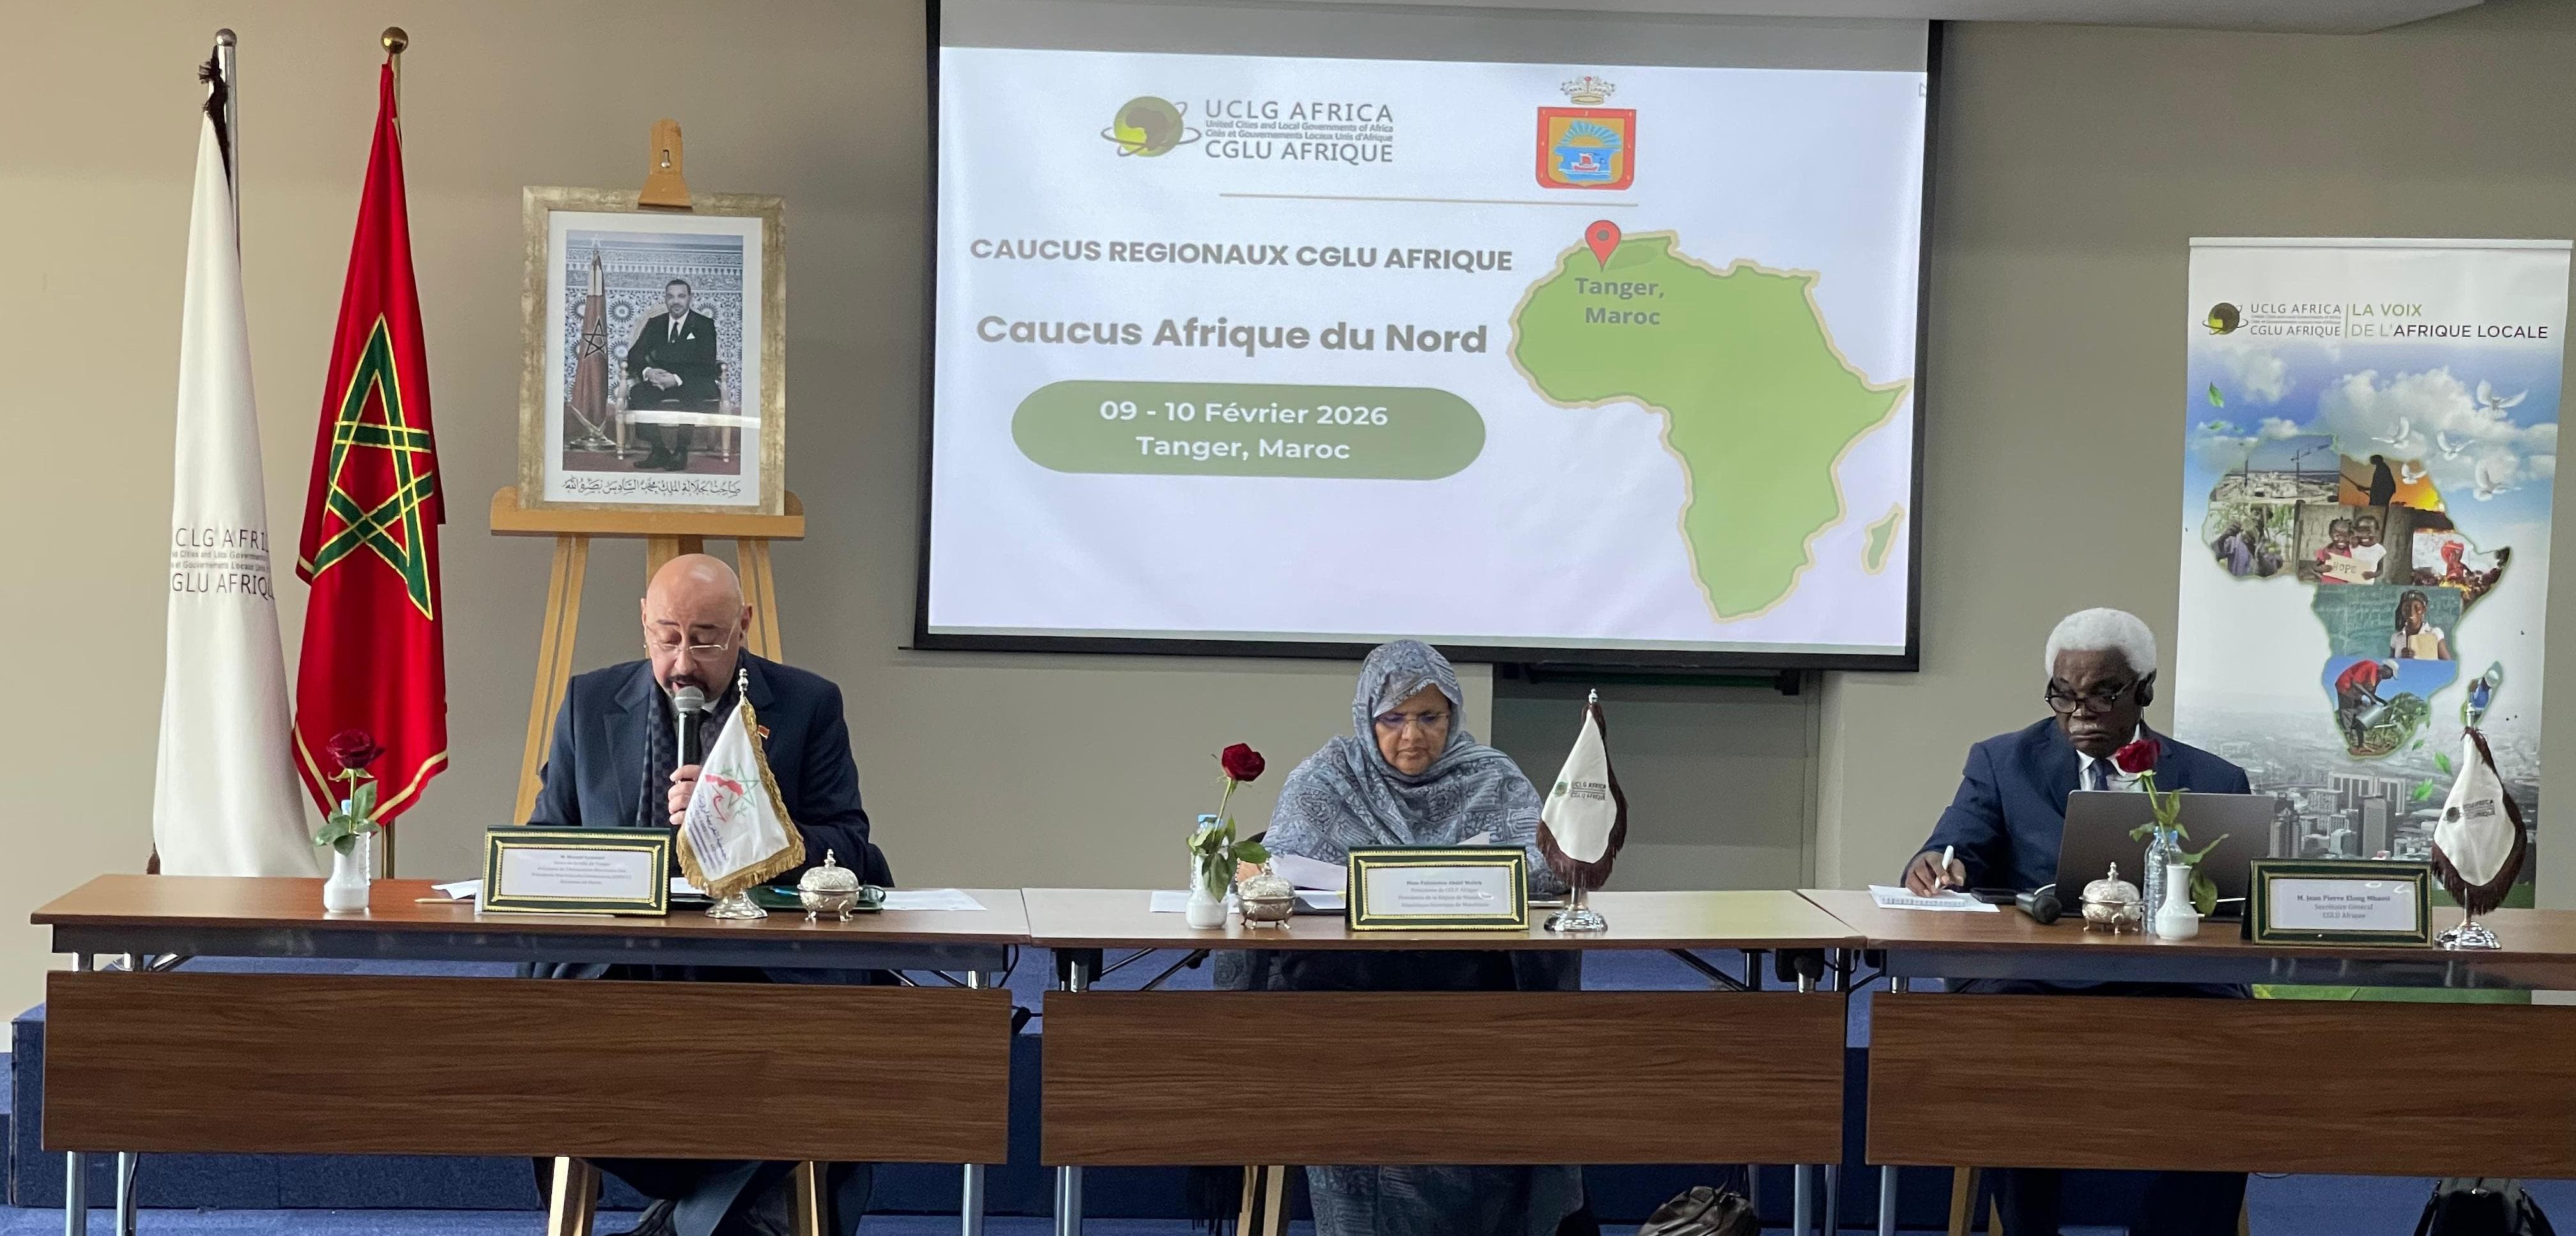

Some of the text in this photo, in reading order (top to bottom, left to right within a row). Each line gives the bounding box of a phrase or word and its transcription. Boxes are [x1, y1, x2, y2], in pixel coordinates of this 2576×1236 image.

[1206, 100, 1393, 123] UCLG AFRICA
[1206, 120, 1234, 128] United
[1235, 120, 1259, 128] Cities
[1278, 121, 1300, 130] Local
[1301, 122, 1357, 131] Governments
[1369, 124, 1393, 132] Africa
[1238, 130, 1303, 139] Gouvernements
[1305, 132, 1333, 140] Locaux
[1335, 132, 1354, 141] Unis
[1205, 140, 1393, 166] CGLU AFRIQUE
[970, 239, 1513, 273] CAUCUS REGIONAUX CGLU AFRIQUE
[1574, 277, 1664, 300] Tanger,
[1585, 307, 1660, 325] Maroc
[2251, 304, 2342, 314] UCLG AFRICA
[2352, 304, 2422, 316] LA VOIX
[977, 316, 1487, 357] Caucus Afrique du Nord
[2250, 325, 2340, 337] CGLU AFRIQUE
[2351, 324, 2548, 339] DE L'AFRIQUE LOCALE
[1100, 400, 1137, 421] 09
[1165, 402, 1195, 422] 10
[1206, 401, 1308, 424] Février
[1317, 405, 1388, 426] 2026
[1135, 435, 1350, 460] Tanger, Maroc
[176, 528, 268, 553] CLG AFRI
[172, 573, 275, 600] GLU AFRIQU
